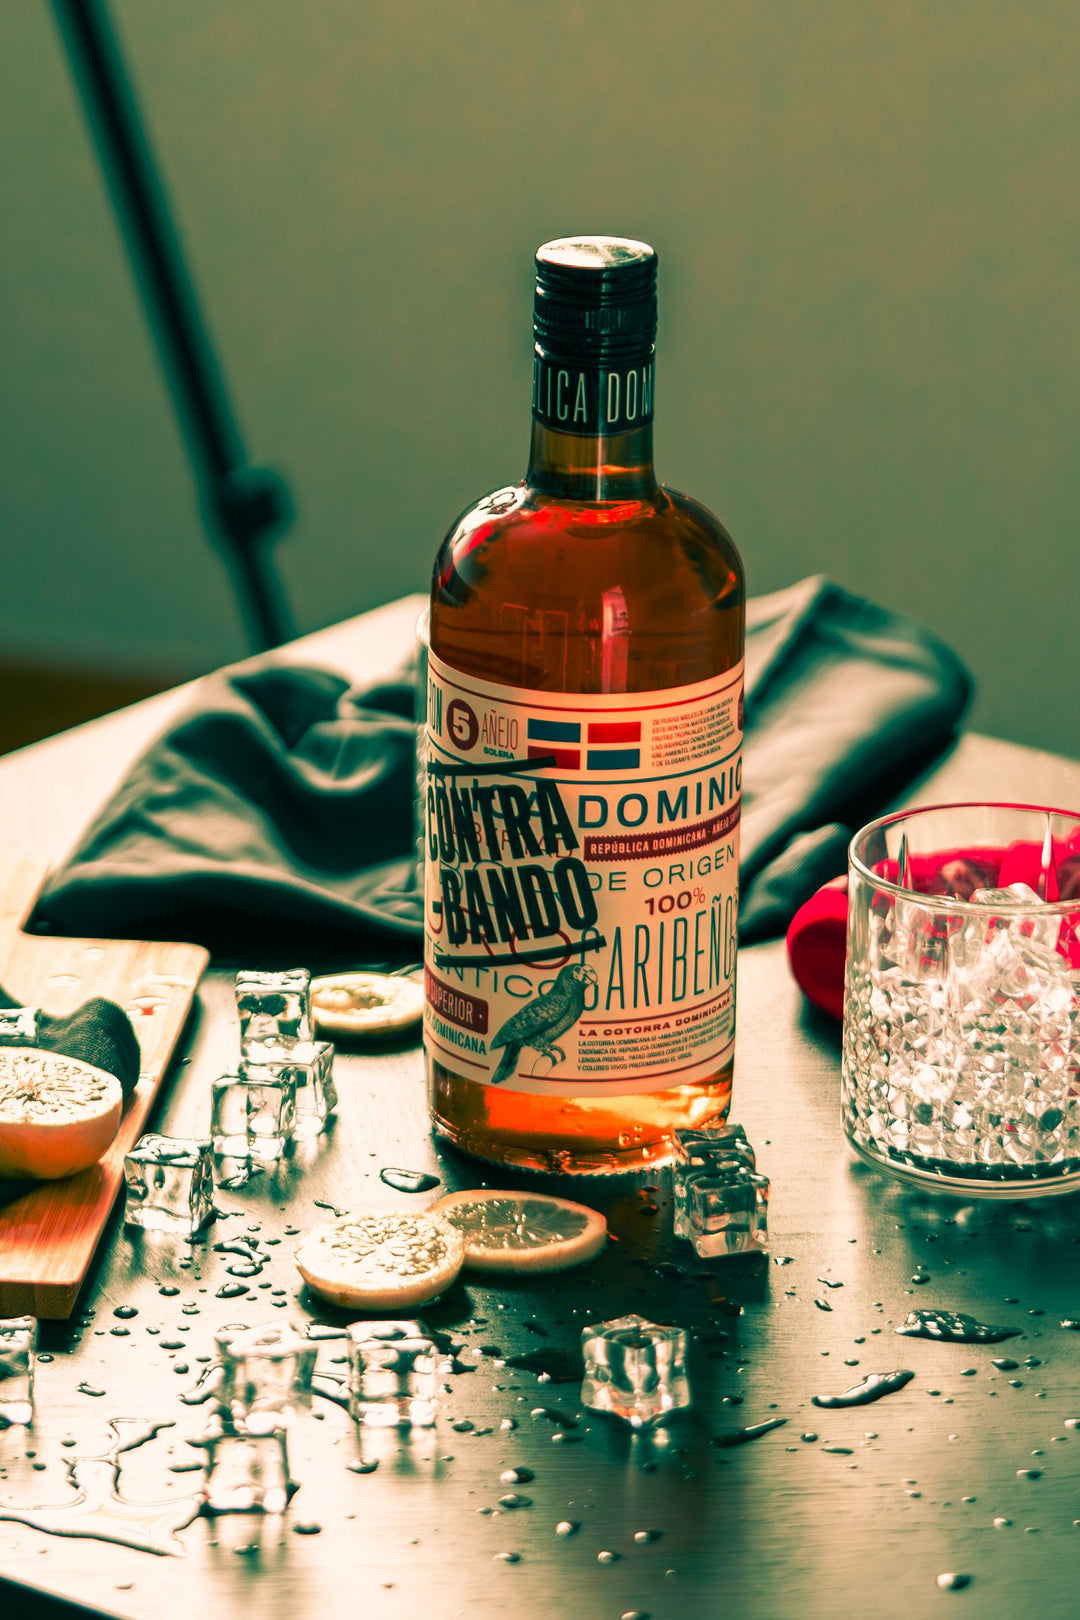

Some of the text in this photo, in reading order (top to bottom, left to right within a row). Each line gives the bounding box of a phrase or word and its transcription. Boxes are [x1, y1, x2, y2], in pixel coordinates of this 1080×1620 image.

[481, 708, 519, 751] AÑEJO
[483, 746, 515, 760] SOLERA
[427, 779, 580, 862] CONTRA
[590, 841, 649, 855] REPÚBLICA
[652, 828, 706, 851] DOMINICANA
[587, 871, 627, 892] DE
[643, 841, 735, 888] ORIGEN
[644, 887, 706, 916] 100%
[431, 985, 474, 1026] SUPERIOR
[603, 1022, 670, 1035] COTORRA
[675, 996, 729, 1026] DOMINICANA
